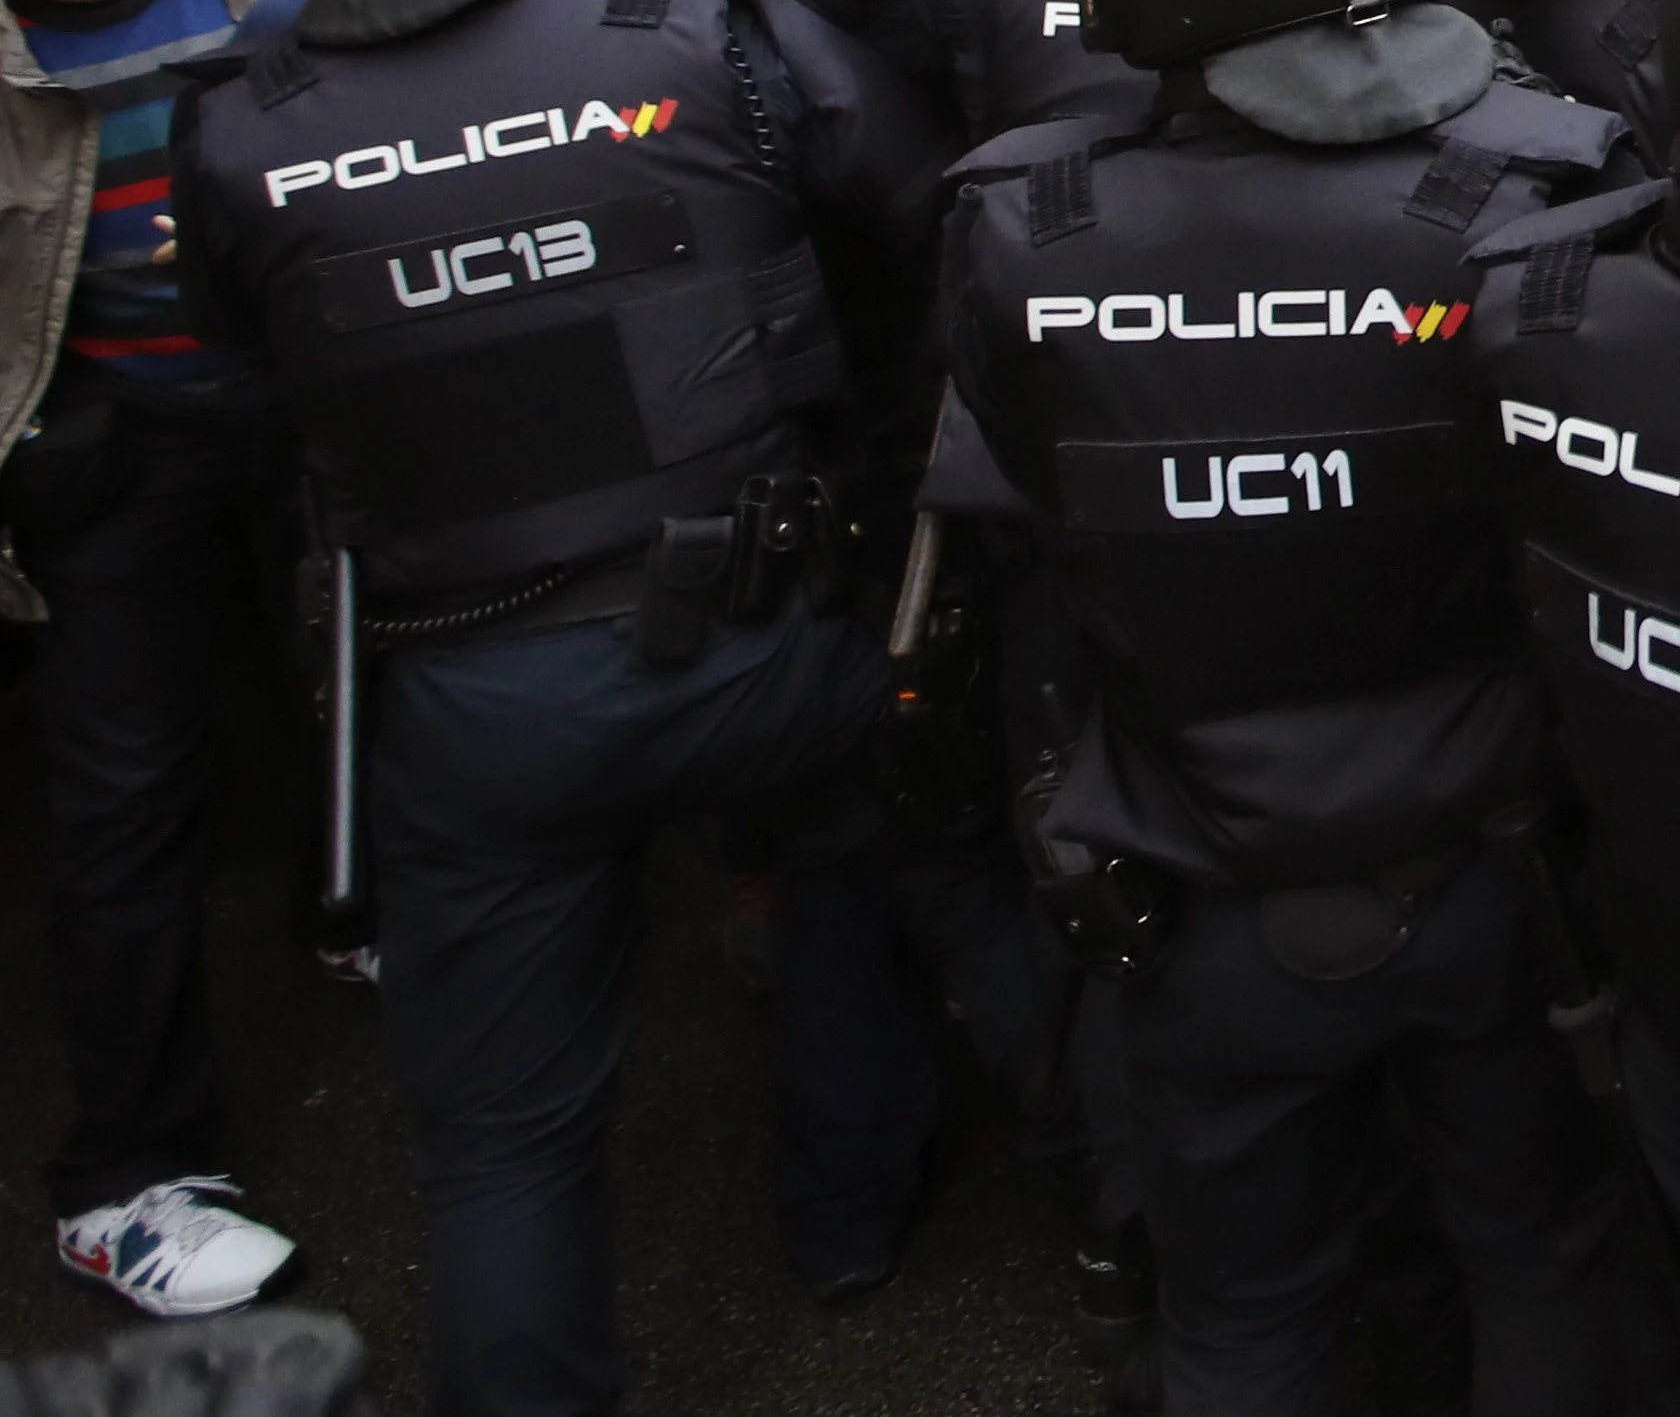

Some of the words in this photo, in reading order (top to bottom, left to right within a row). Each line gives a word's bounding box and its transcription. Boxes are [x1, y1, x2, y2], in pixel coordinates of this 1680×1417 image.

[265, 99, 630, 208] POLICIA
[388, 220, 596, 309] UC13
[1026, 288, 1414, 342] POLICIA
[1162, 449, 1355, 520] UC11
